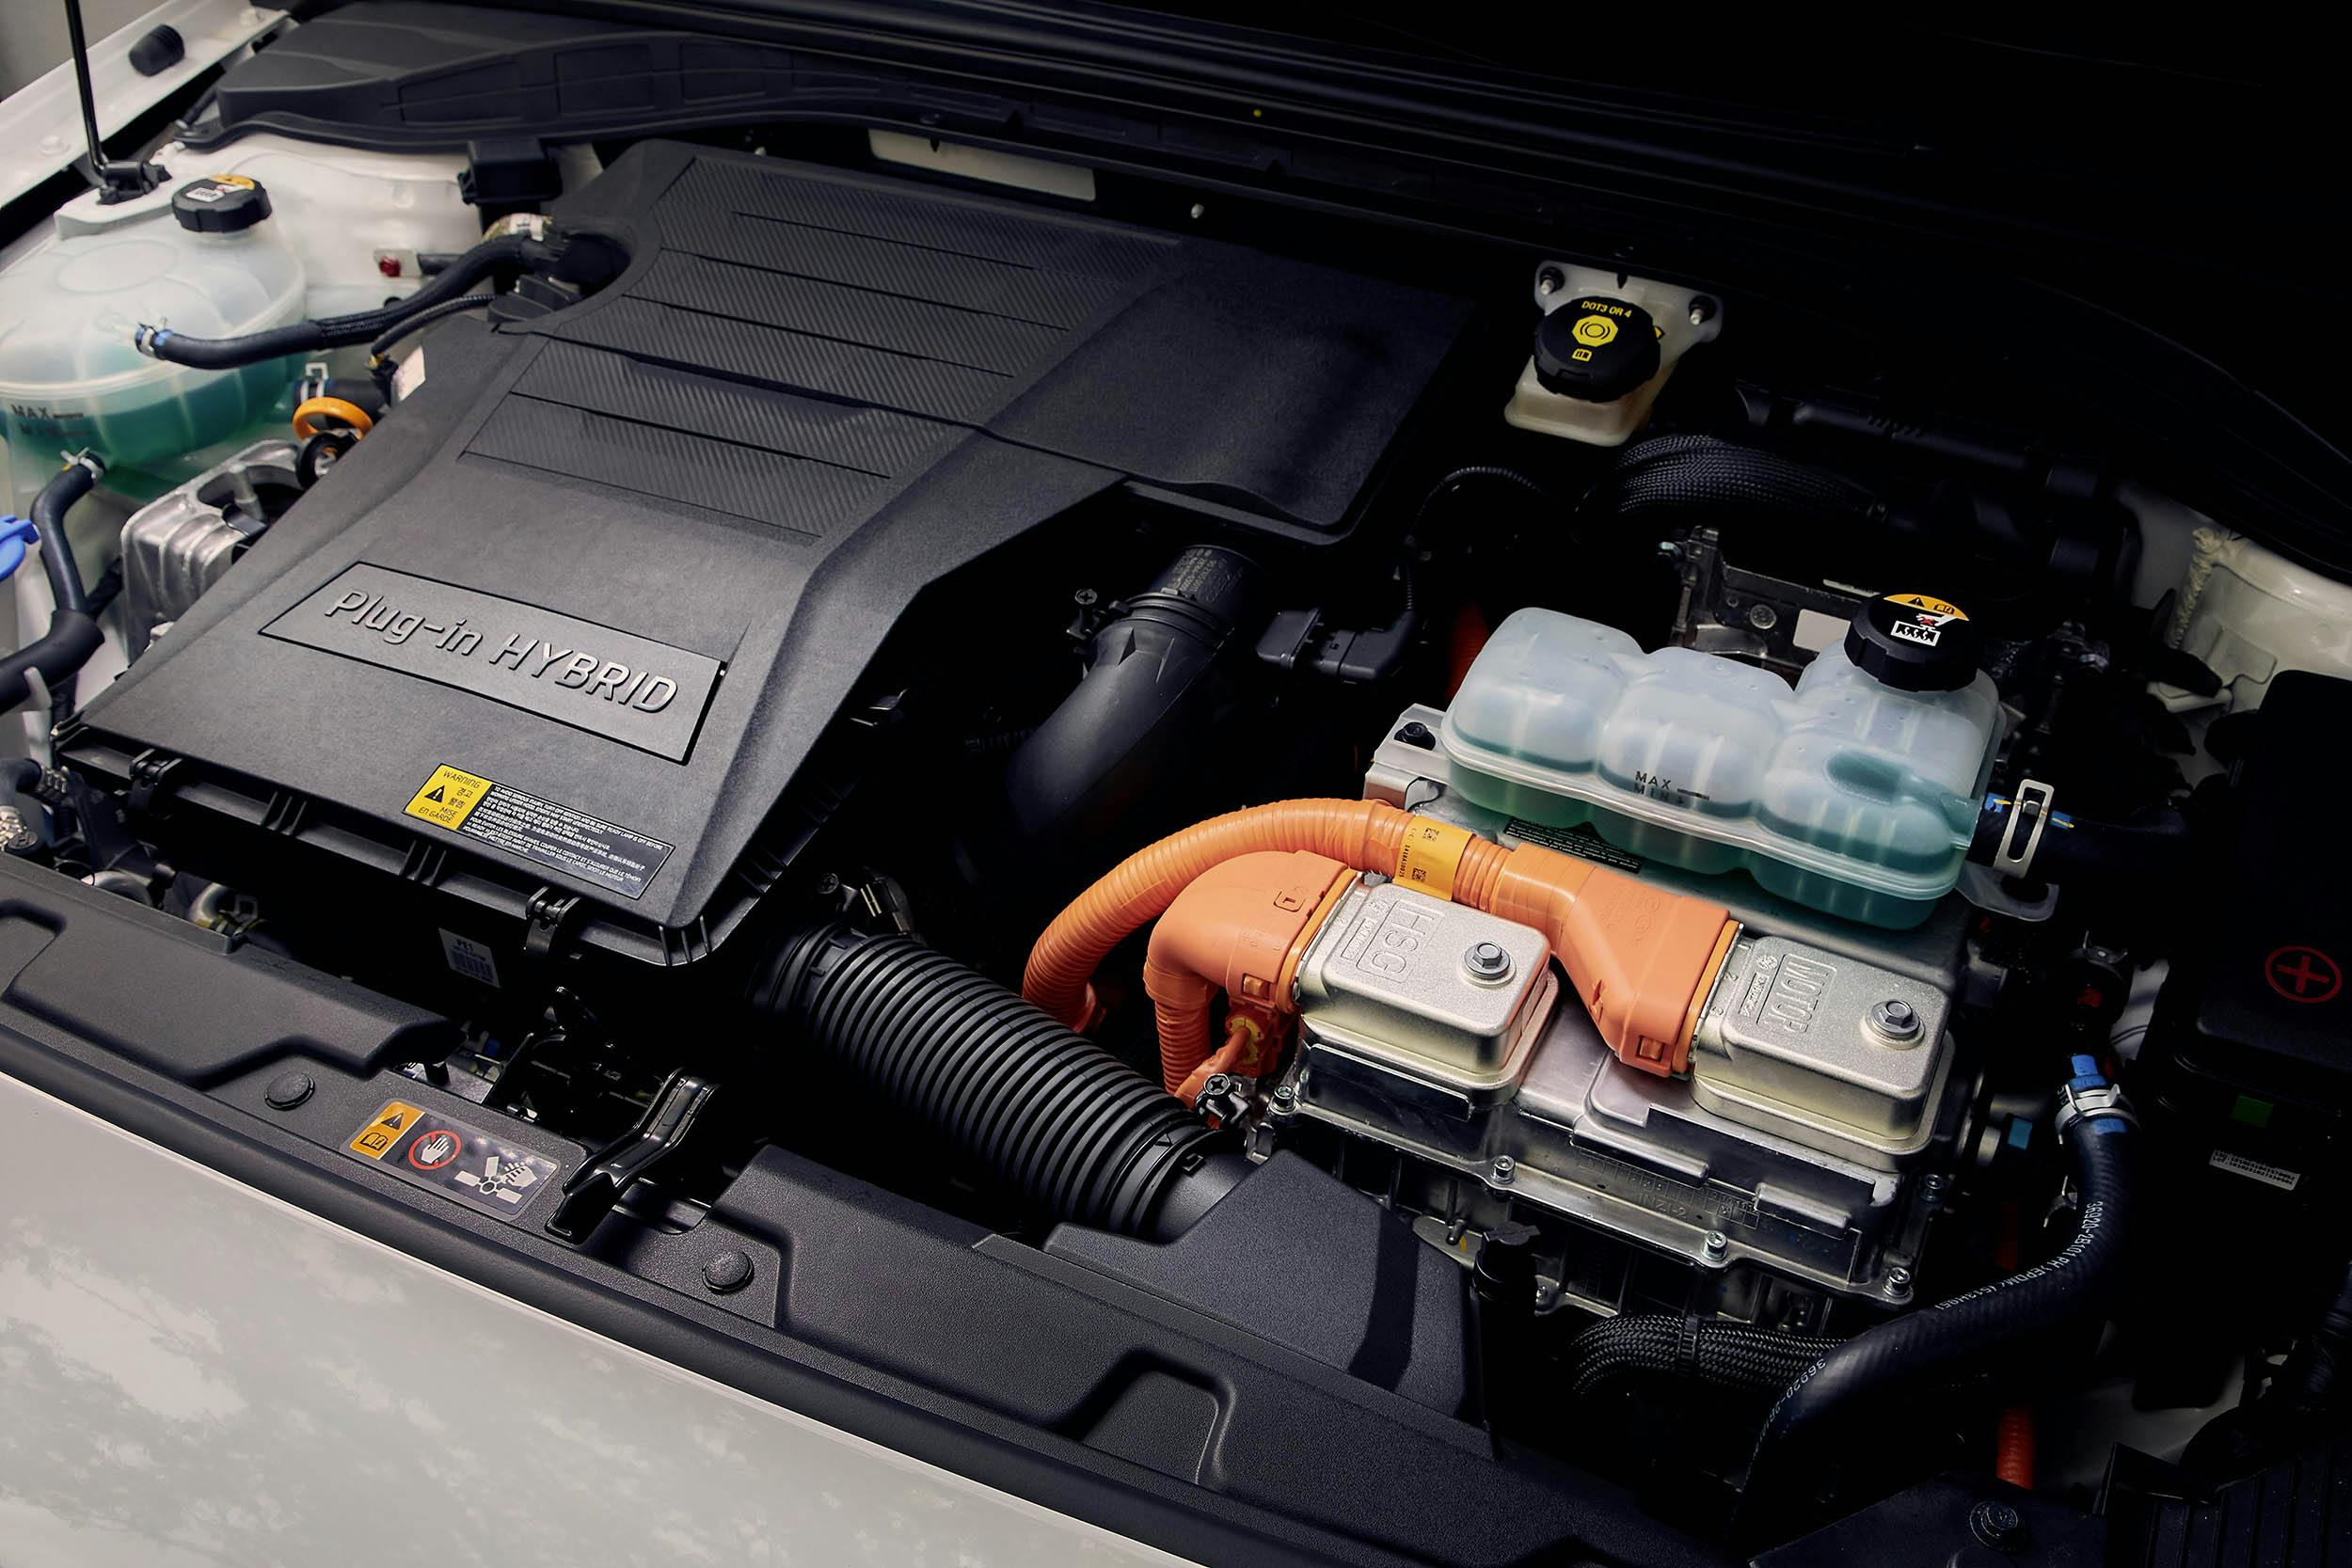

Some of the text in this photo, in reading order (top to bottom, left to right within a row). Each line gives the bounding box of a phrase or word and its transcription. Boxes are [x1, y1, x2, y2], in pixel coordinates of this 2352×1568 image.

[1581, 300, 1632, 318] DOT3 OR 4
[326, 589, 679, 714] Plug-in HYBRID
[443, 769, 481, 789] WARNING
[1635, 770, 1672, 790] MAX
[418, 805, 453, 824] EN GARDE
[439, 806, 457, 817] MISE
[1372, 906, 1435, 974] HSG
